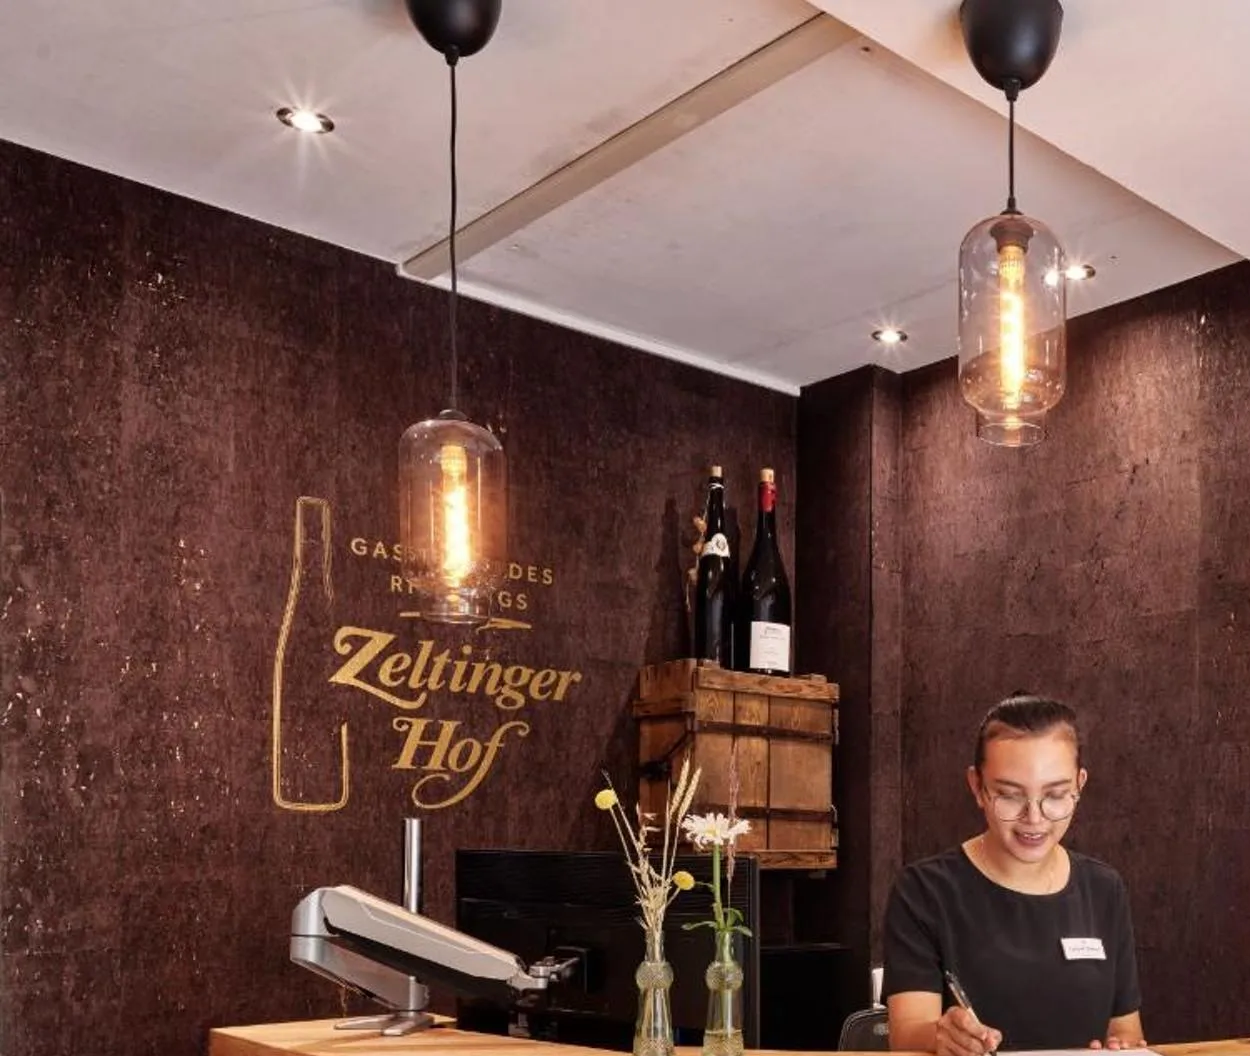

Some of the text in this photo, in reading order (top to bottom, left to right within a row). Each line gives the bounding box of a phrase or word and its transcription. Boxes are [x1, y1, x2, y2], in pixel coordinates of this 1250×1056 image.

[508, 563, 554, 586] DES
[329, 626, 582, 710] Zeltinger
[391, 717, 530, 809] Hof
